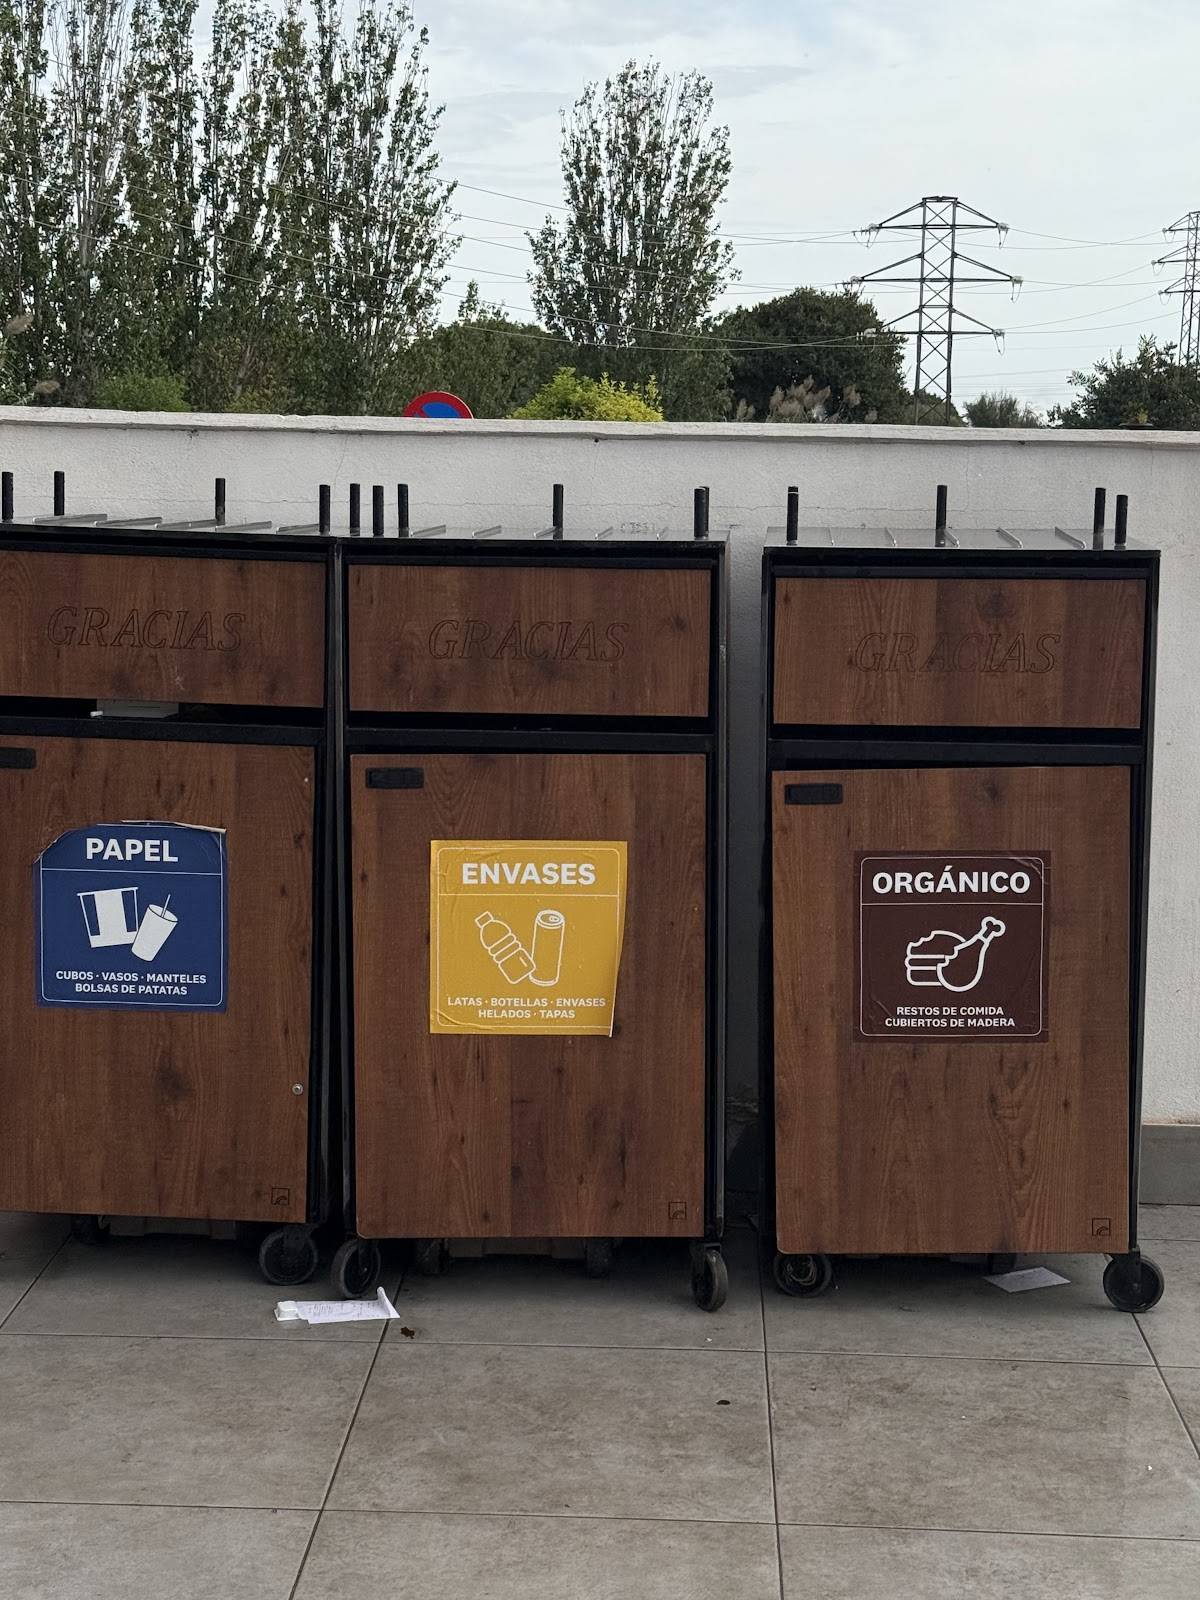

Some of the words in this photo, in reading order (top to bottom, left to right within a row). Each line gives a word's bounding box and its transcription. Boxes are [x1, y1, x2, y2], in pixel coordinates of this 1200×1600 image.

[47, 605, 246, 651] GRACIAS
[428, 618, 629, 662] GRACIAS
[854, 632, 1061, 673] GRACIAS
[86, 837, 179, 863] PAPEL
[462, 862, 597, 885] ENVASES
[872, 865, 1031, 894] ORGÁNICO
[56, 971, 94, 980] CUBOS
[101, 972, 138, 981] VASOS
[146, 974, 207, 983] MANTELES
[75, 983, 118, 993] BOLSAS
[121, 984, 136, 993] DE
[138, 985, 188, 995] PATATAS
[447, 997, 482, 1007] LATAS
[490, 997, 548, 1007] BOTELLAS
[556, 998, 606, 1008] ENVASES
[896, 1007, 940, 1015] RESTOS
[942, 1006, 957, 1015] DE
[960, 1007, 1004, 1015] COMIDA
[478, 1009, 531, 1019] HELADOS
[539, 1009, 576, 1019] TAPAS
[885, 1018, 947, 1027] CUBIERTOS
[950, 1018, 965, 1027] DE
[967, 1018, 1015, 1027] MADERA
